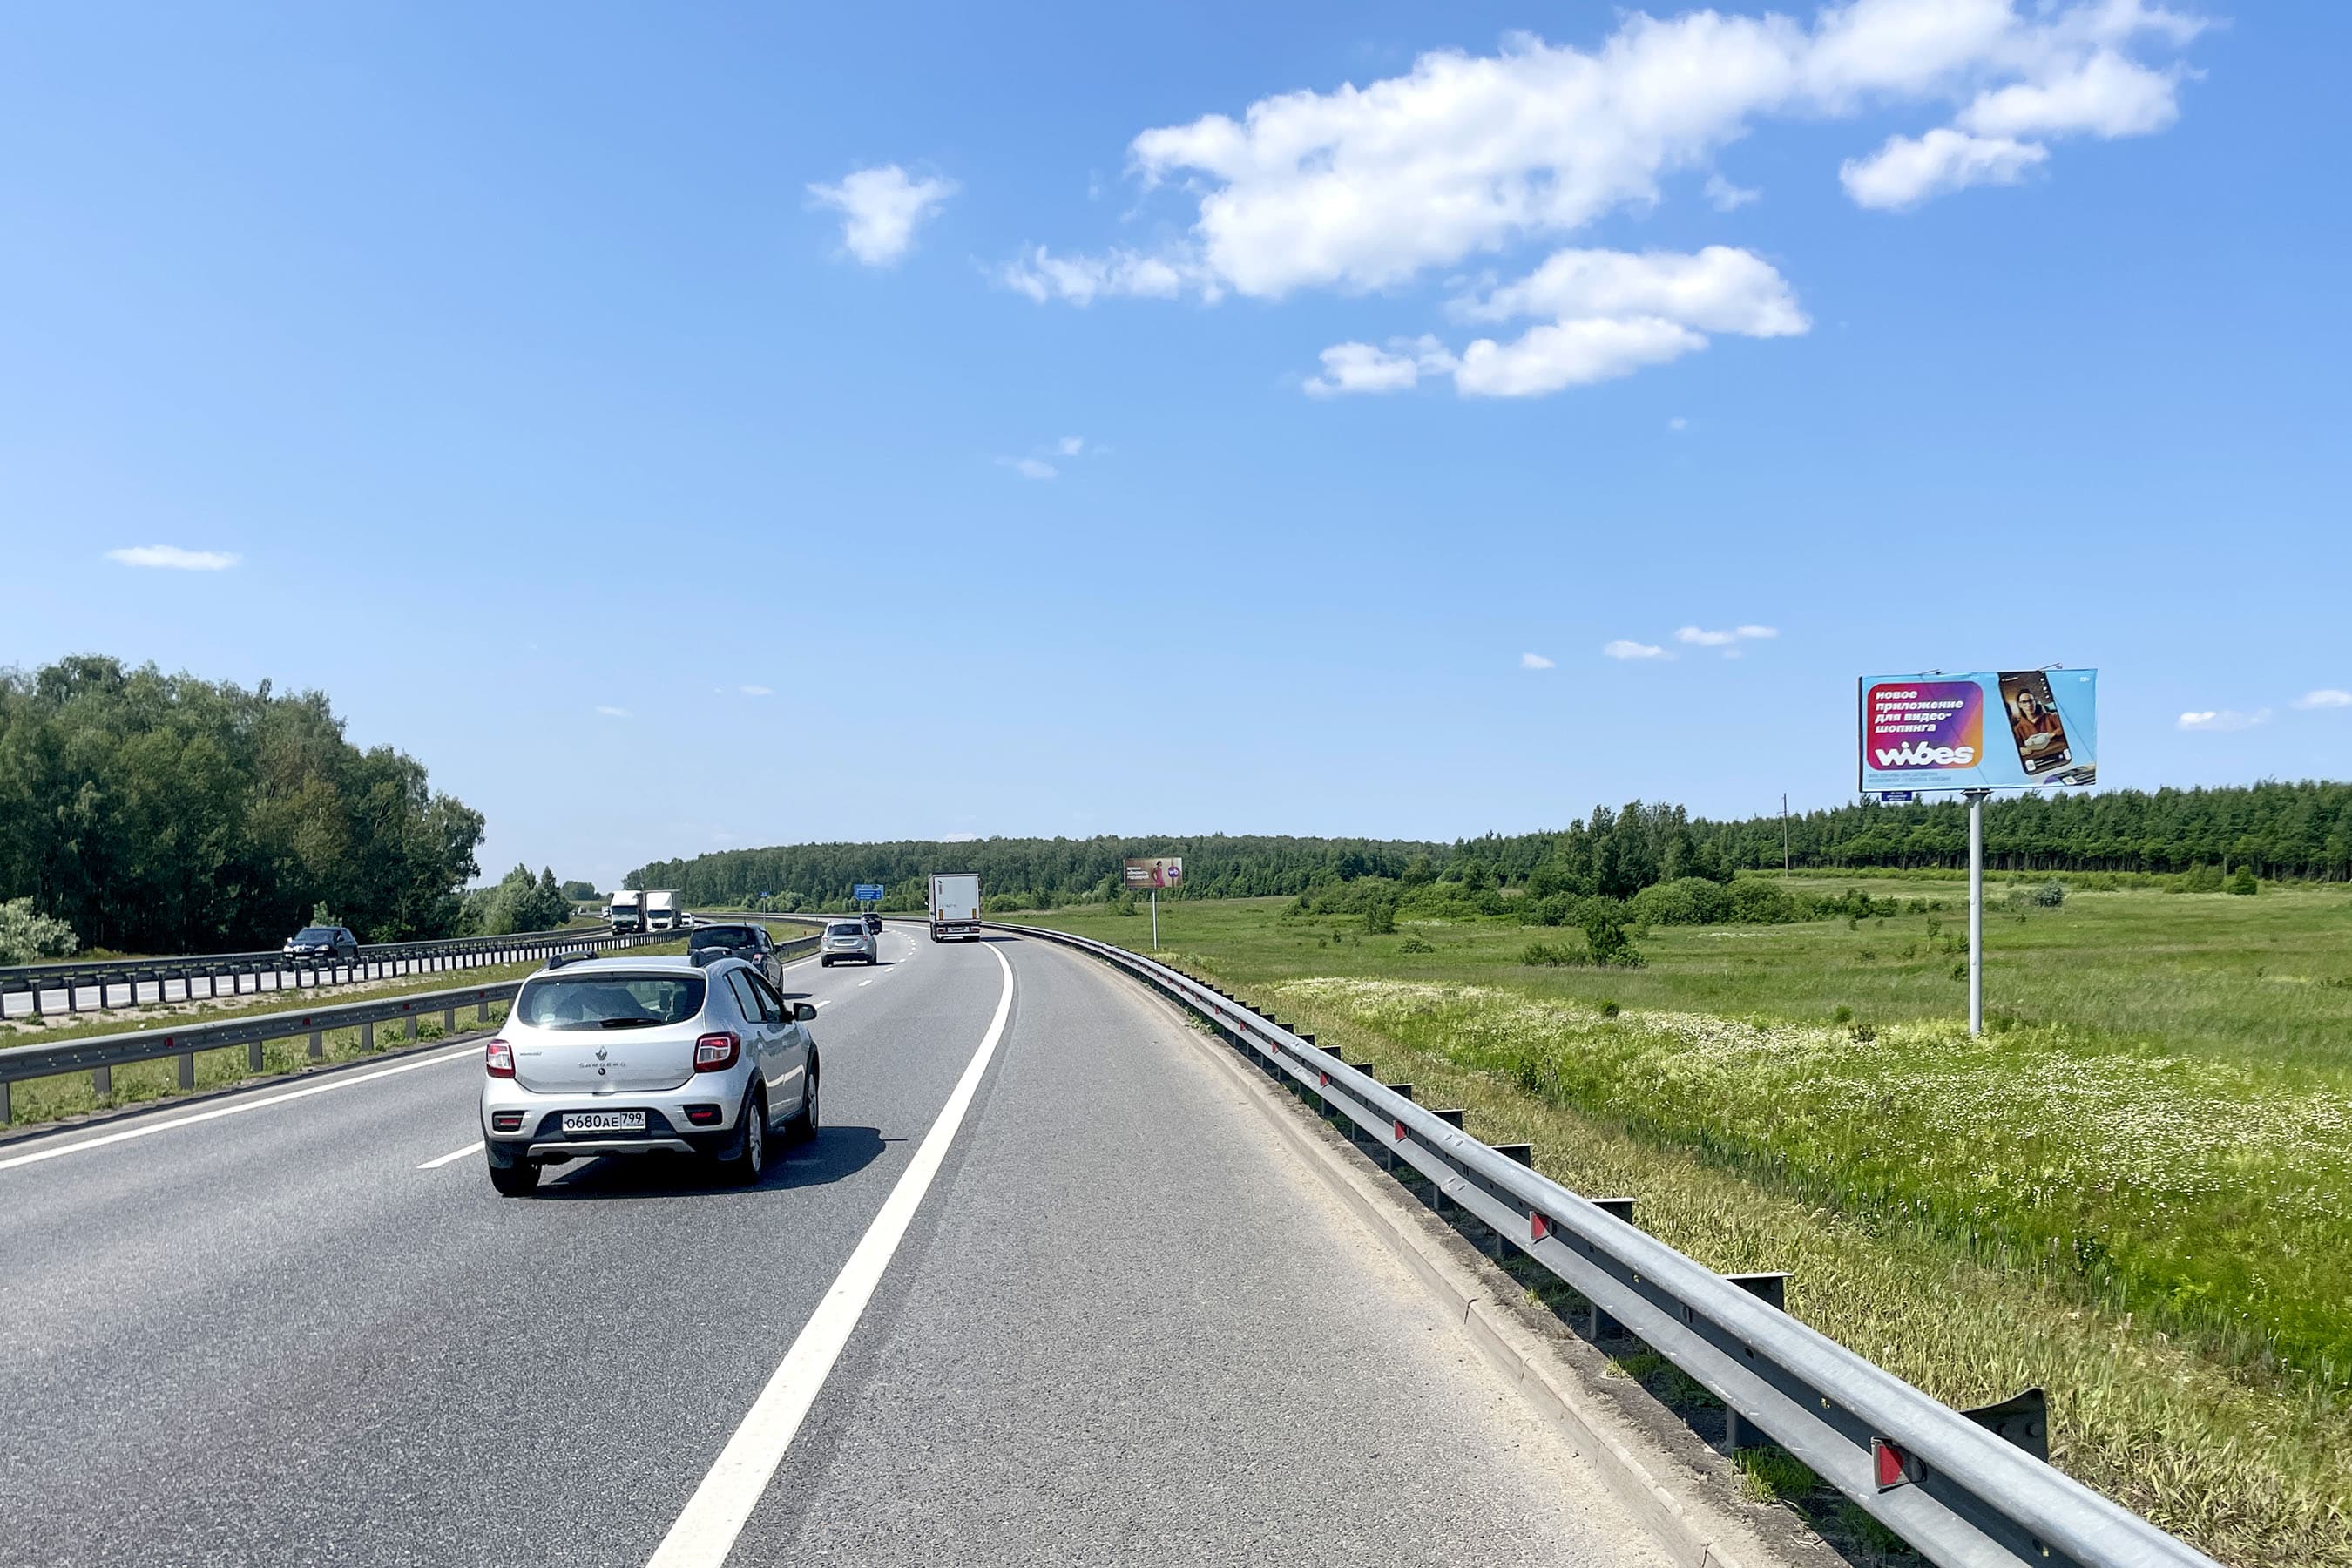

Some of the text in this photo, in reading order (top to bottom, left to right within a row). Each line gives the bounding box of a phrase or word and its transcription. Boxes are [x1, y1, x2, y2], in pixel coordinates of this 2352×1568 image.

[1876, 691, 1917, 700] новое
[1876, 700, 1963, 713] приложение
[1875, 713, 1951, 724] для видео-
[1875, 724, 1936, 733] шопинга
[1875, 741, 1975, 766] wibes
[621, 1113, 642, 1123] 799
